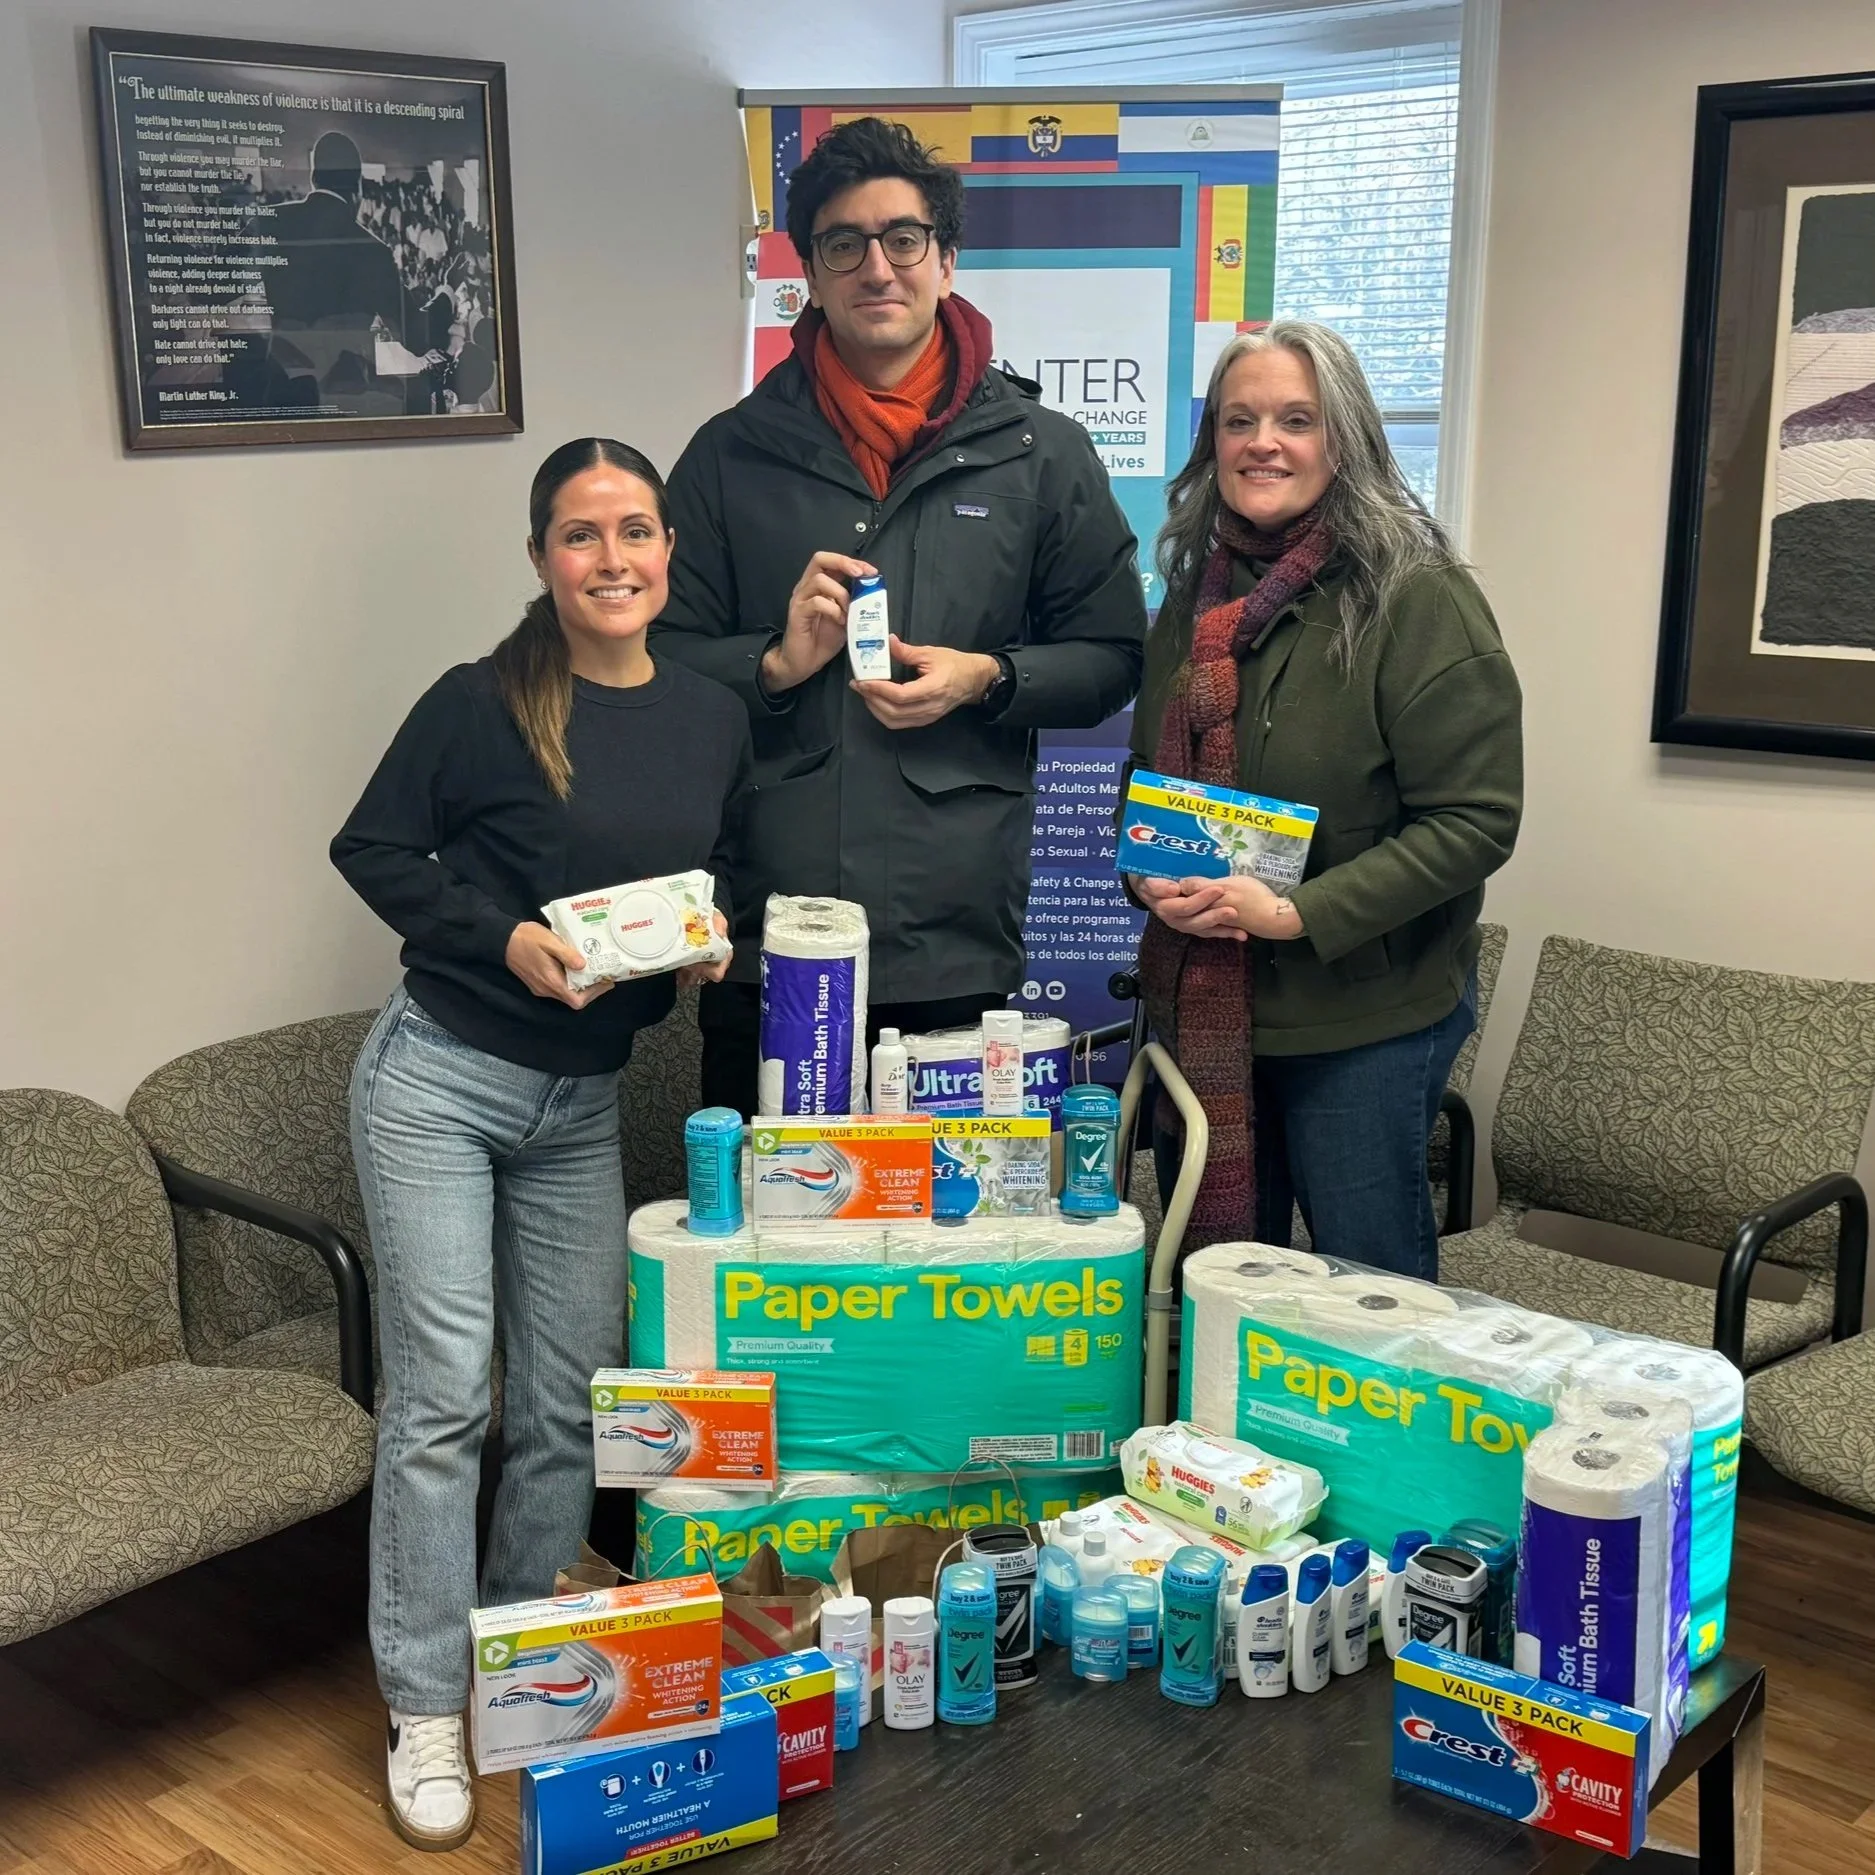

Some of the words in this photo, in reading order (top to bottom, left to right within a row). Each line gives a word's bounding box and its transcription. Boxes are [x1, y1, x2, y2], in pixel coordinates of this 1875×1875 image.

[158, 84, 203, 102] ultimate
[207, 88, 259, 106] weakness
[262, 91, 272, 107] of
[275, 93, 317, 110] violence
[320, 95, 329, 110] is
[331, 96, 352, 112] that
[354, 97, 362, 113] it
[364, 98, 373, 113] is
[375, 101, 381, 114] a
[384, 99, 436, 119] descending
[438, 103, 464, 120] spiral
[155, 354, 172, 365] only
[172, 354, 188, 363] love
[189, 355, 202, 363] can
[203, 353, 212, 363] do
[159, 391, 184, 401] Martin
[184, 390, 208, 400] Luther
[208, 390, 227, 401] King,
[228, 390, 239, 399] Jr.
[1072, 410, 1147, 425] CHANGE
[1102, 433, 1144, 443] YEARS
[1036, 763, 1048, 772] su
[1052, 761, 1115, 774] Propiedad
[1049, 783, 1096, 794] Adultos
[1099, 783, 1121, 794] Ma
[1035, 804, 1054, 814] ata
[1058, 804, 1074, 815] de
[1167, 795, 1216, 816] VALUE
[1221, 807, 1230, 818] 3
[1234, 810, 1276, 829] PACK
[1047, 825, 1085, 838] Pareja
[1128, 825, 1211, 856] Crest
[1030, 847, 1044, 857] so
[1047, 846, 1088, 857] Sexual
[1254, 864, 1299, 882] WHITENING
[1063, 877, 1071, 888] &
[1073, 877, 1115, 890] Change
[571, 897, 612, 911] HUGGIES
[1028, 895, 1061, 905] tencia
[1063, 896, 1088, 907] para
[1091, 896, 1106, 906] las
[621, 919, 654, 933] HUGGIES
[1035, 913, 1070, 923] ofrece
[1072, 916, 1131, 926] programas
[1050, 933, 1057, 942] y
[1060, 931, 1075, 941] las
[1077, 932, 1091, 942] 24
[1094, 933, 1124, 943] horas
[1038, 949, 1052, 959] de
[1055, 949, 1086, 960] todos
[1089, 950, 1104, 960] los
[1107, 951, 1138, 961] delito
[814, 973, 829, 1021] Tissue
[1026, 984, 1037, 996] in
[814, 1034, 829, 1060] Bath
[797, 1059, 813, 1092] Soft
[992, 1069, 1017, 1077] OLAY
[908, 1067, 984, 1097] Ultra
[1028, 1100, 1034, 1108] 6
[819, 1129, 853, 1138] VALUE
[857, 1128, 862, 1137] 3
[866, 1128, 895, 1137] PACK
[957, 1122, 966, 1134] 3
[971, 1122, 1012, 1134] PACK
[1075, 1131, 1108, 1142] Degree
[760, 1174, 805, 1184] Aquafresh
[874, 1168, 926, 1178] EXTREME
[1002, 1174, 1046, 1185] WHITENING
[879, 1178, 920, 1188] CLEAN
[723, 1270, 908, 1331] Paper
[917, 1266, 1124, 1322] Towels
[735, 1339, 783, 1352] Premium
[785, 1339, 826, 1354] Quality
[1069, 1336, 1081, 1351] 4
[1095, 1333, 1122, 1349] 150
[1246, 1328, 1427, 1428] Paper
[656, 1388, 690, 1398] VALUE
[694, 1389, 700, 1398] 3
[703, 1389, 732, 1399] PACK
[1255, 1403, 1302, 1428] Premium
[1302, 1417, 1340, 1441] Quality
[599, 1430, 645, 1441] Aquafresh
[711, 1430, 765, 1440] EXTREME
[718, 1440, 759, 1449] CLEAN
[1171, 1465, 1216, 1494] HUGGIES
[683, 1517, 842, 1567] Paper
[1209, 1534, 1246, 1557] HUGGIES
[1579, 1538, 1601, 1600] Tissue
[1421, 1576, 1438, 1589] TWIN
[1438, 1581, 1455, 1593] PACK
[1412, 1603, 1445, 1625] Degree
[569, 1619, 616, 1637] VALUE
[621, 1618, 629, 1629] 3
[633, 1610, 673, 1627] PACK
[1579, 1604, 1600, 1647] Bath
[948, 1627, 985, 1641] Degree
[644, 1656, 714, 1678] EXTREME
[1558, 1643, 1577, 1687] Soft
[652, 1671, 706, 1689] CLEAN
[896, 1673, 926, 1685] OLAY
[488, 1690, 551, 1709] Aquafresh
[652, 1684, 704, 1700] WHITENING
[662, 1693, 696, 1706] ACTION
[765, 1685, 791, 1704] CK
[1441, 1677, 1505, 1713] VALUE
[1513, 1701, 1523, 1717] 3
[1530, 1706, 1584, 1738] PACK
[783, 1725, 827, 1754] CAVITY
[1401, 1717, 1507, 1767] Crest
[784, 1741, 826, 1759] PROTECTION
[1570, 1771, 1623, 1805] CAVITY
[703, 1799, 711, 1808] A
[1572, 1790, 1621, 1811] PROTECTION
[652, 1803, 702, 1824] HEALTHIER
[616, 1819, 650, 1835] MOUTH
[646, 1820, 684, 1835] TOGETHER
[629, 1831, 644, 1840] FOR
[670, 1831, 695, 1844] BETTER
[667, 1836, 731, 1862] VALUE
[650, 1856, 659, 1868] 3
